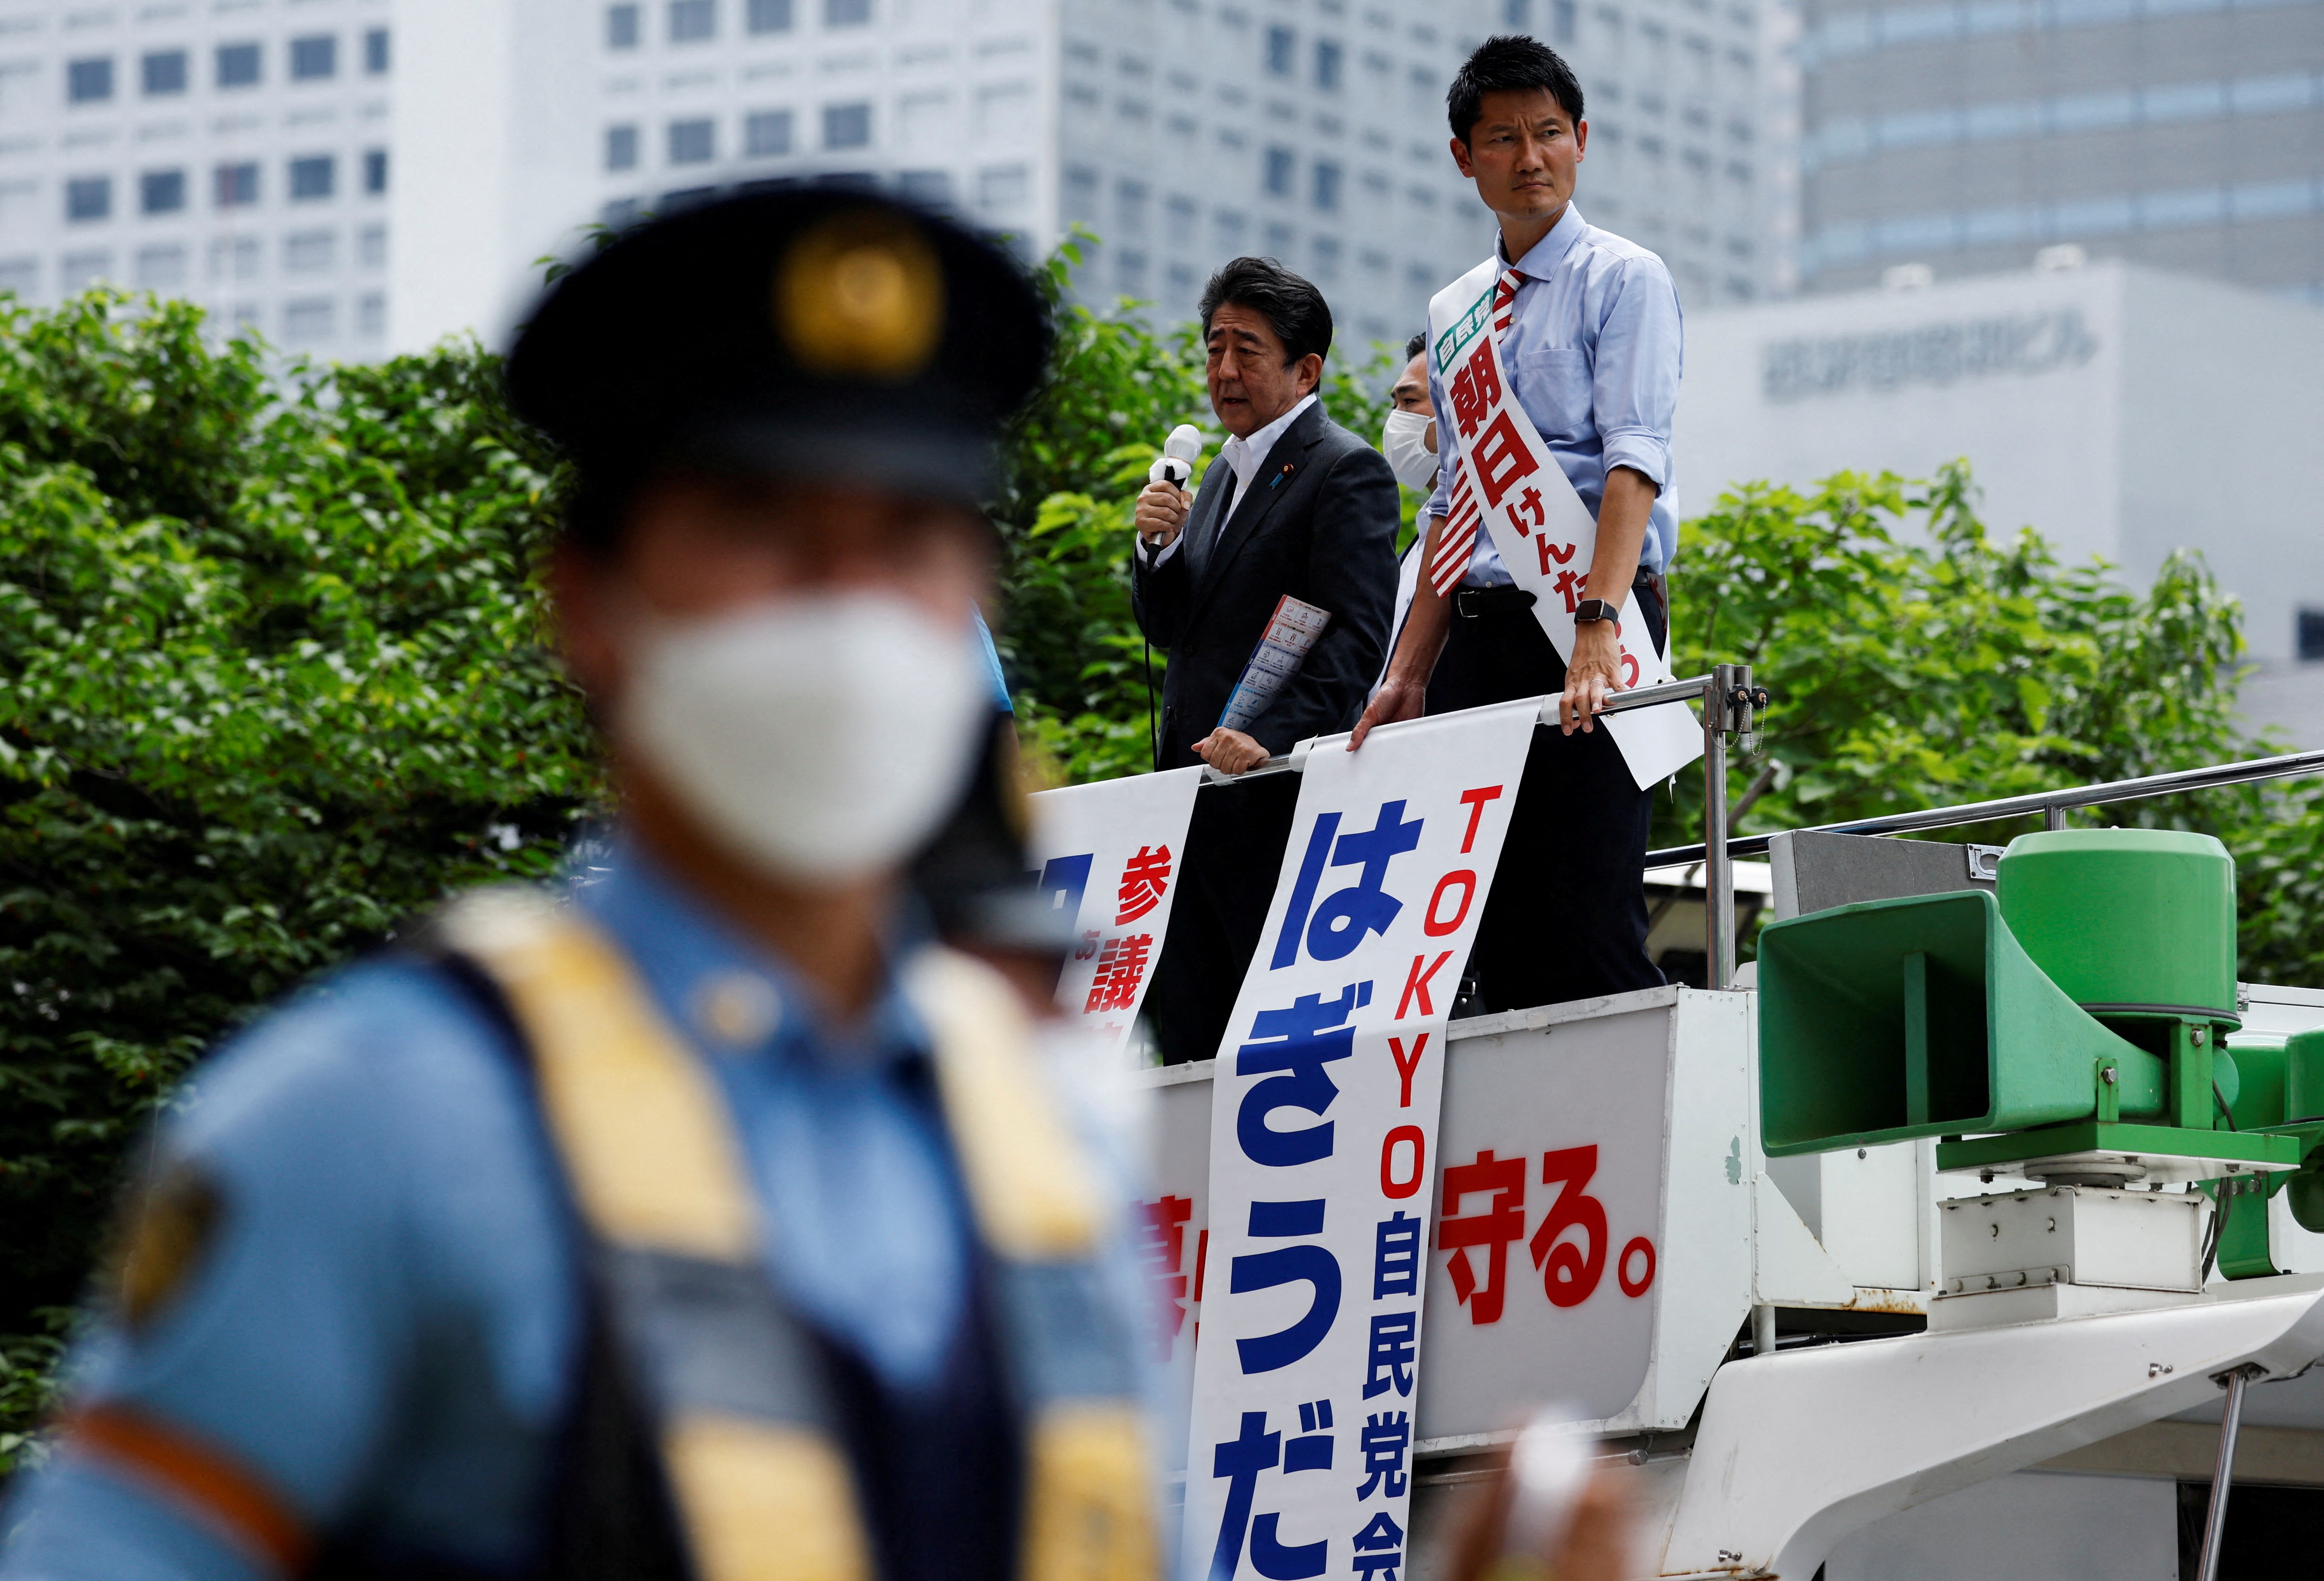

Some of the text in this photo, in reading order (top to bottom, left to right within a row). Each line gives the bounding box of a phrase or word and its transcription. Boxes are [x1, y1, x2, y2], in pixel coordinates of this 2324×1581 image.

[1438, 294, 1490, 368] 自民党
[1207, 799, 1425, 1581] はぎうだ
